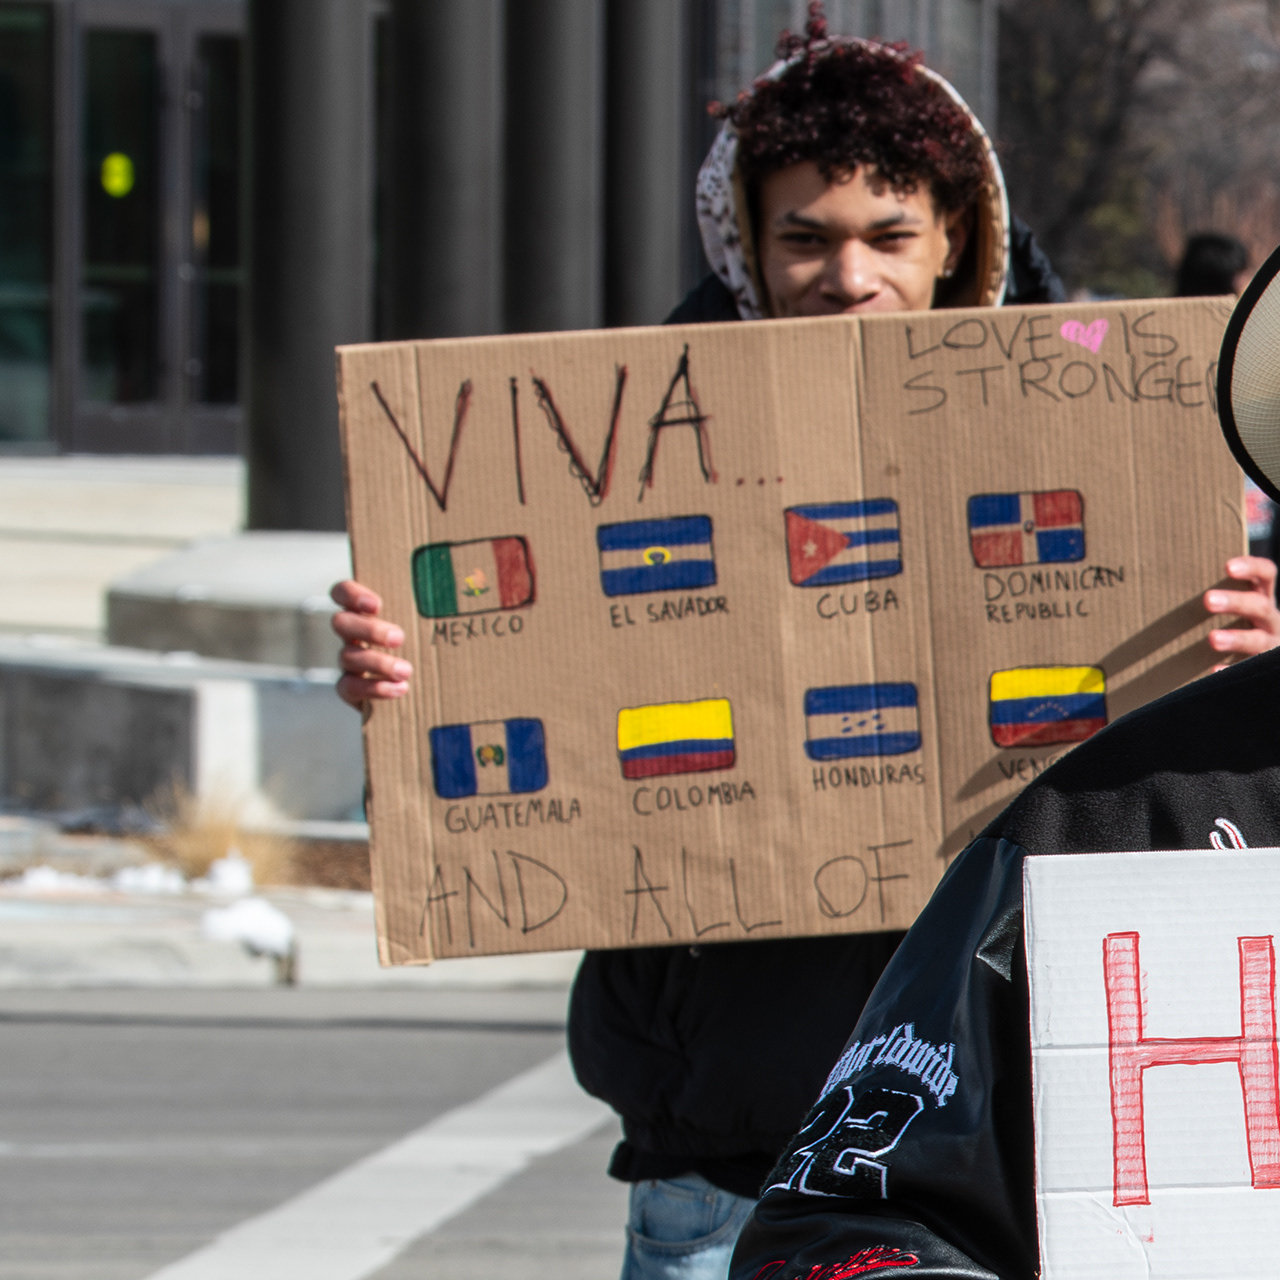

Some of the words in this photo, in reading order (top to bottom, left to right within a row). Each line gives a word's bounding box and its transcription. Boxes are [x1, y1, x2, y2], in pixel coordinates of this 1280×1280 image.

[906, 314, 1063, 362] LOVE
[1119, 311, 1179, 358] IS
[984, 566, 1125, 602] DOMINICAN
[609, 604, 637, 629] EL
[816, 588, 899, 620] CUBA
[985, 599, 1090, 623] REPUBLIC
[431, 614, 524, 646] MEXICO
[812, 762, 926, 791] HONDURAS
[633, 781, 756, 816] COLOMBIA
[445, 798, 582, 834] GUATEMALA
[420, 848, 568, 948] AND
[624, 843, 783, 940] ALL
[813, 838, 914, 924] OF
